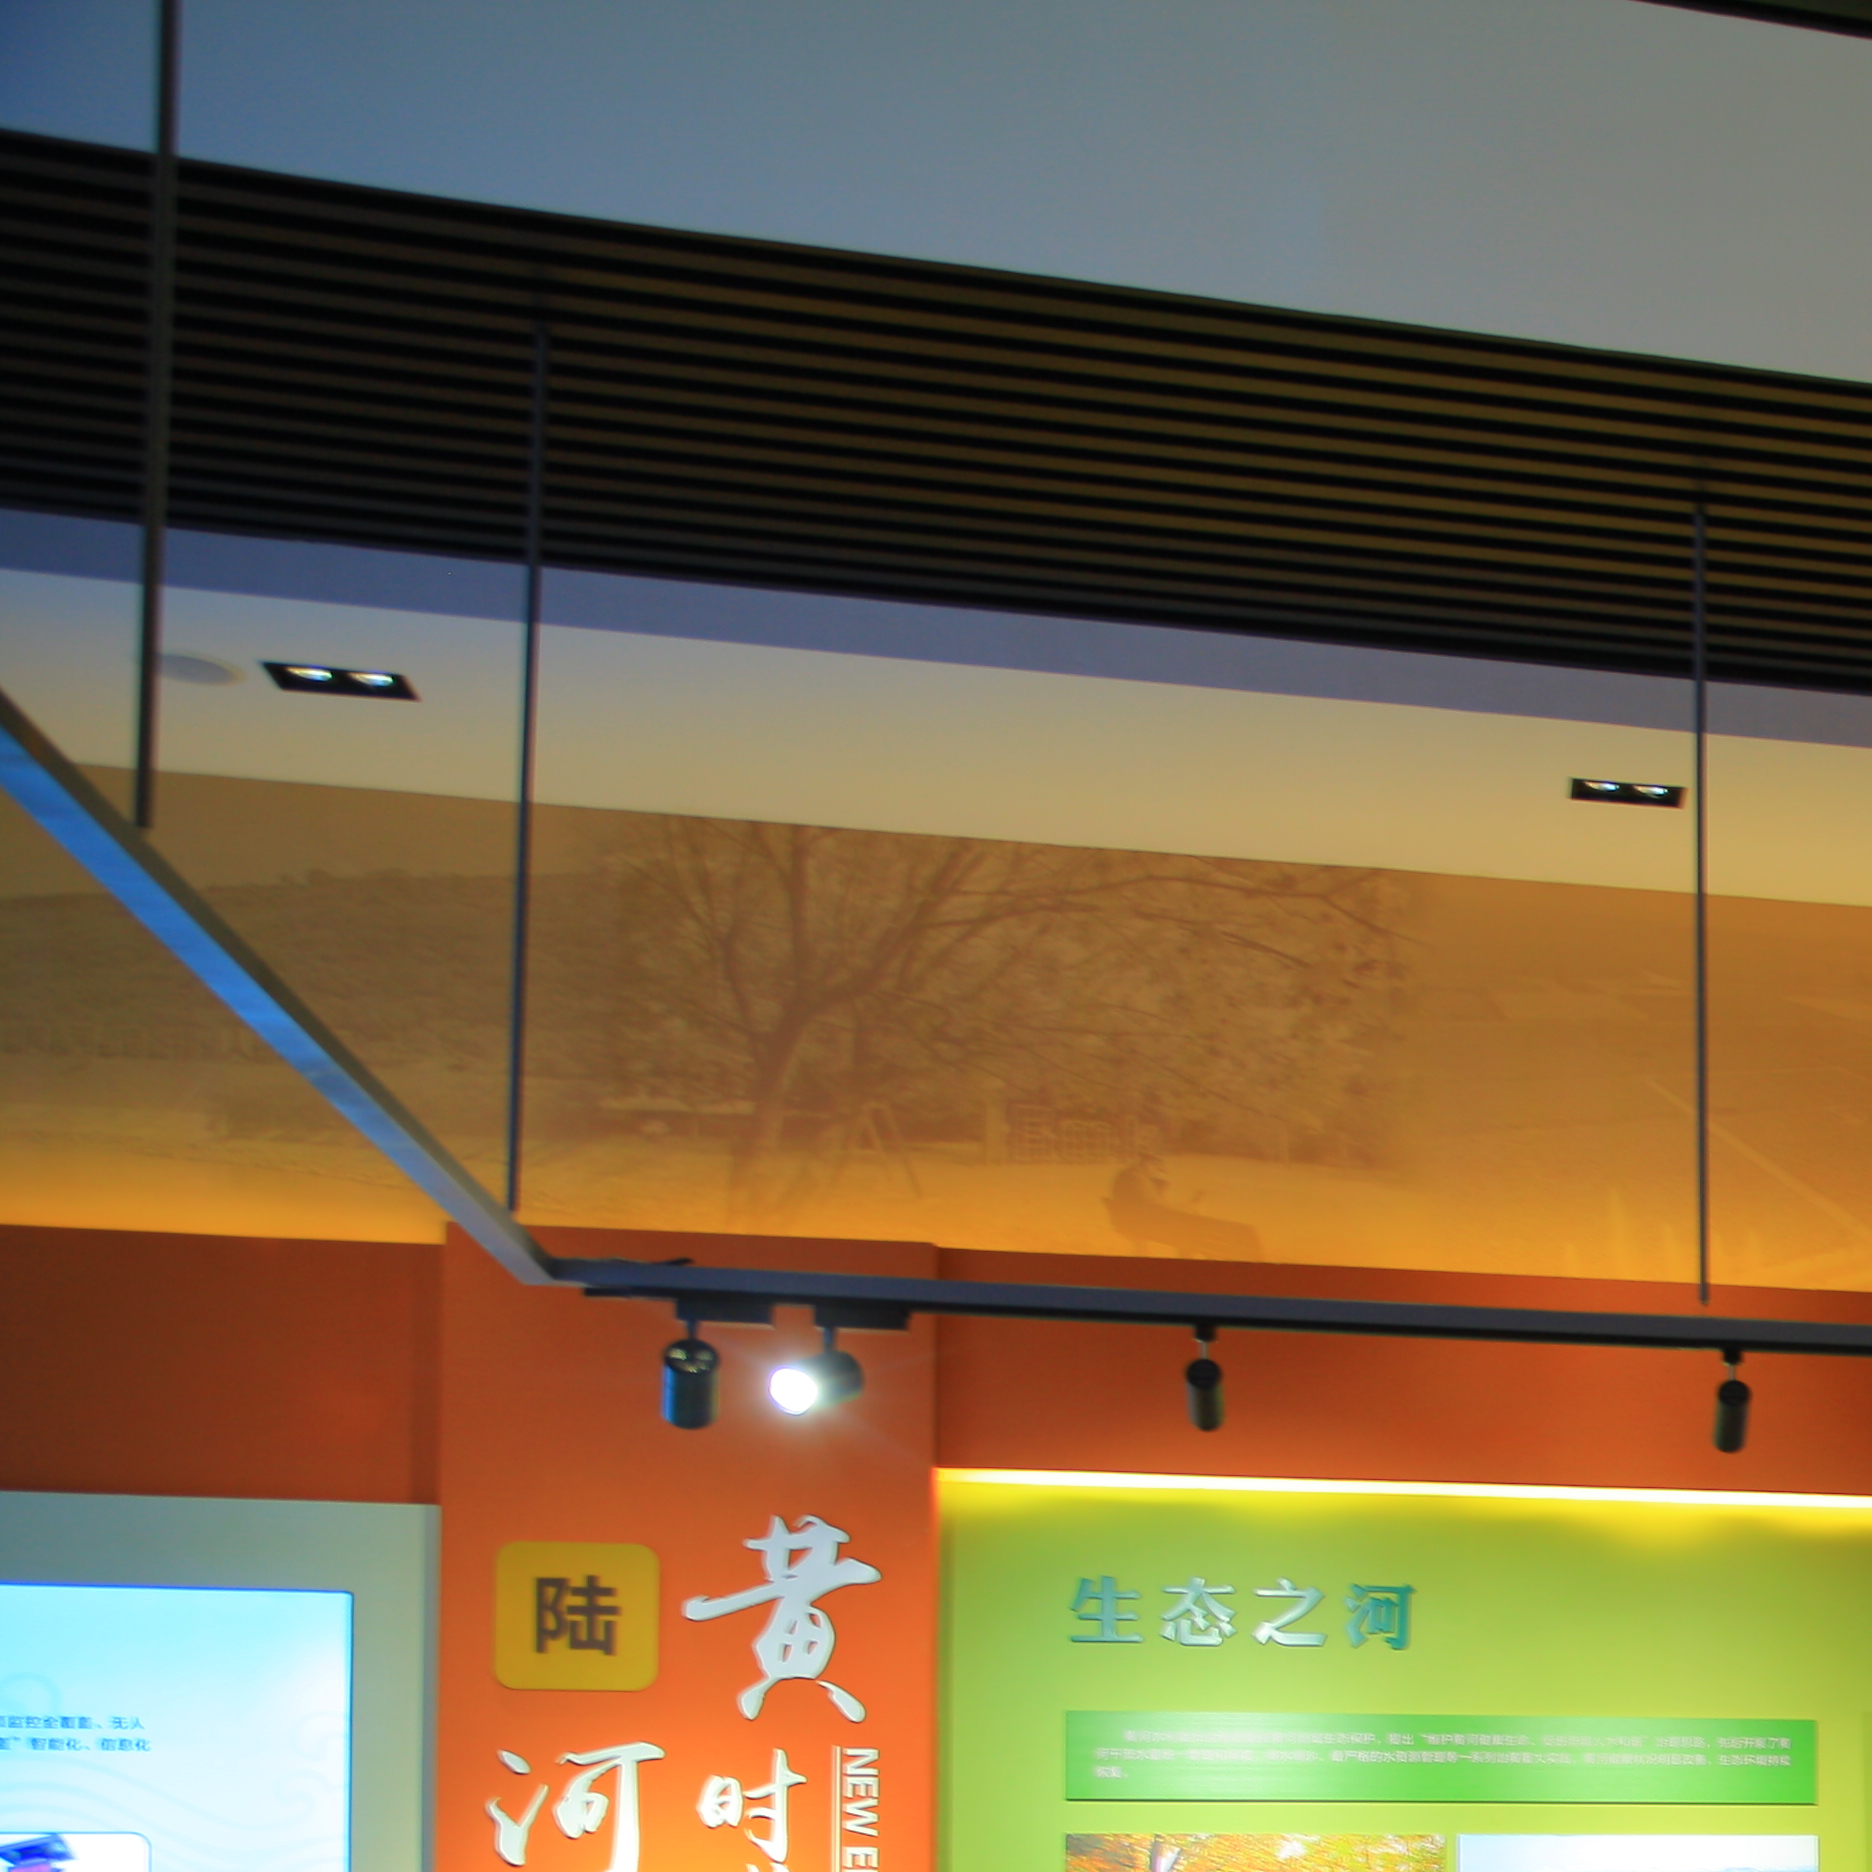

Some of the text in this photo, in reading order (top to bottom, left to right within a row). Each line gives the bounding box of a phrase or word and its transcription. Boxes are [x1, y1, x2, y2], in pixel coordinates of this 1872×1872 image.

[532, 1575, 622, 1656] 陆
[1068, 1575, 1416, 1651] 生态之河
[842, 1746, 880, 1836] NEW
